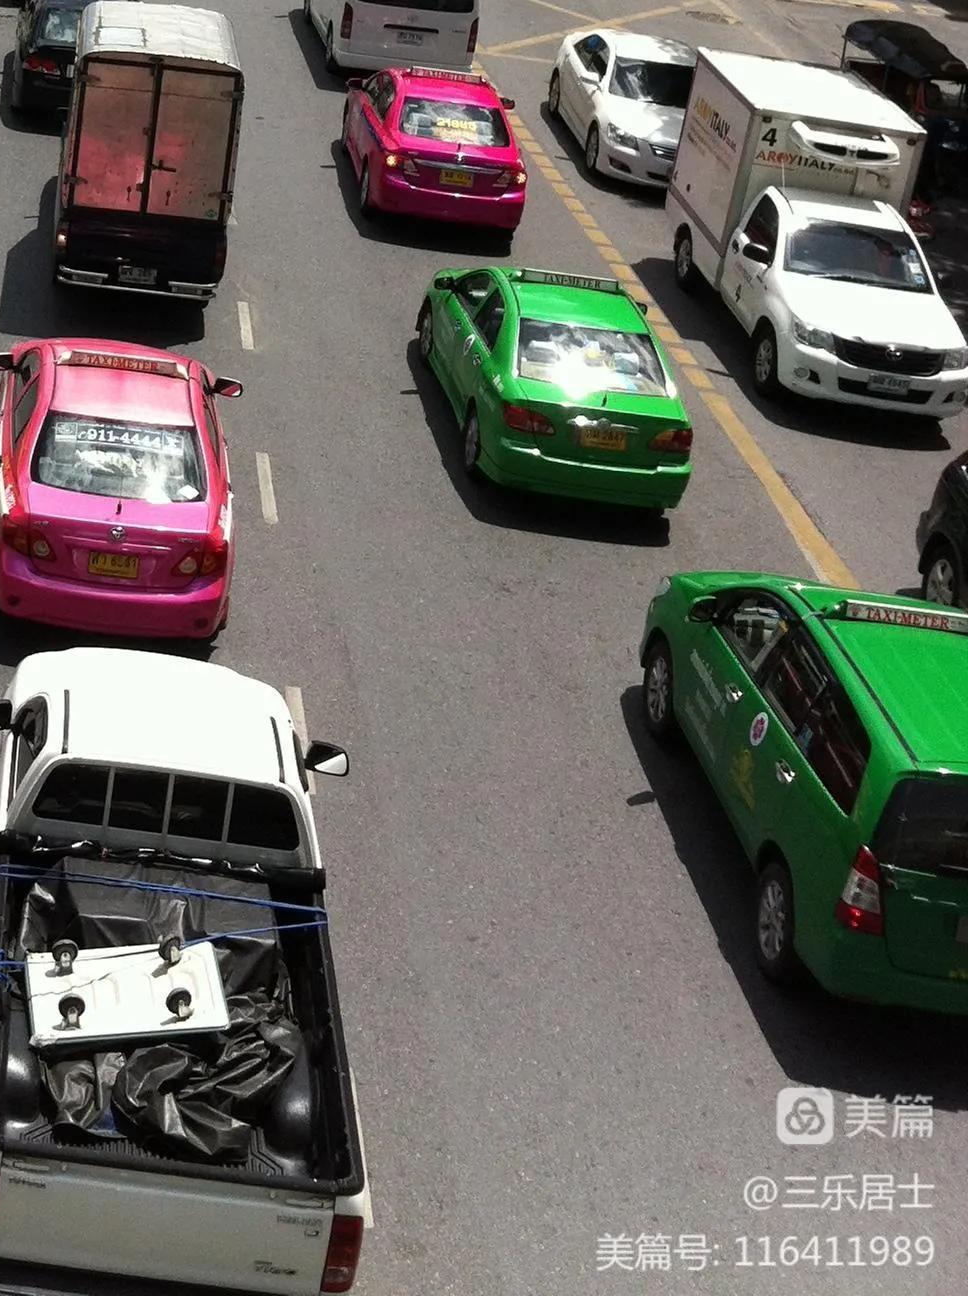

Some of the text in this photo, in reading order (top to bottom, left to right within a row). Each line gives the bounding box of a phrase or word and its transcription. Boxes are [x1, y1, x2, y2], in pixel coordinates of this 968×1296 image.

[761, 127, 778, 147] 4
[543, 273, 602, 289] TAXI-METER
[866, 607, 950, 630] TAXI-METER
